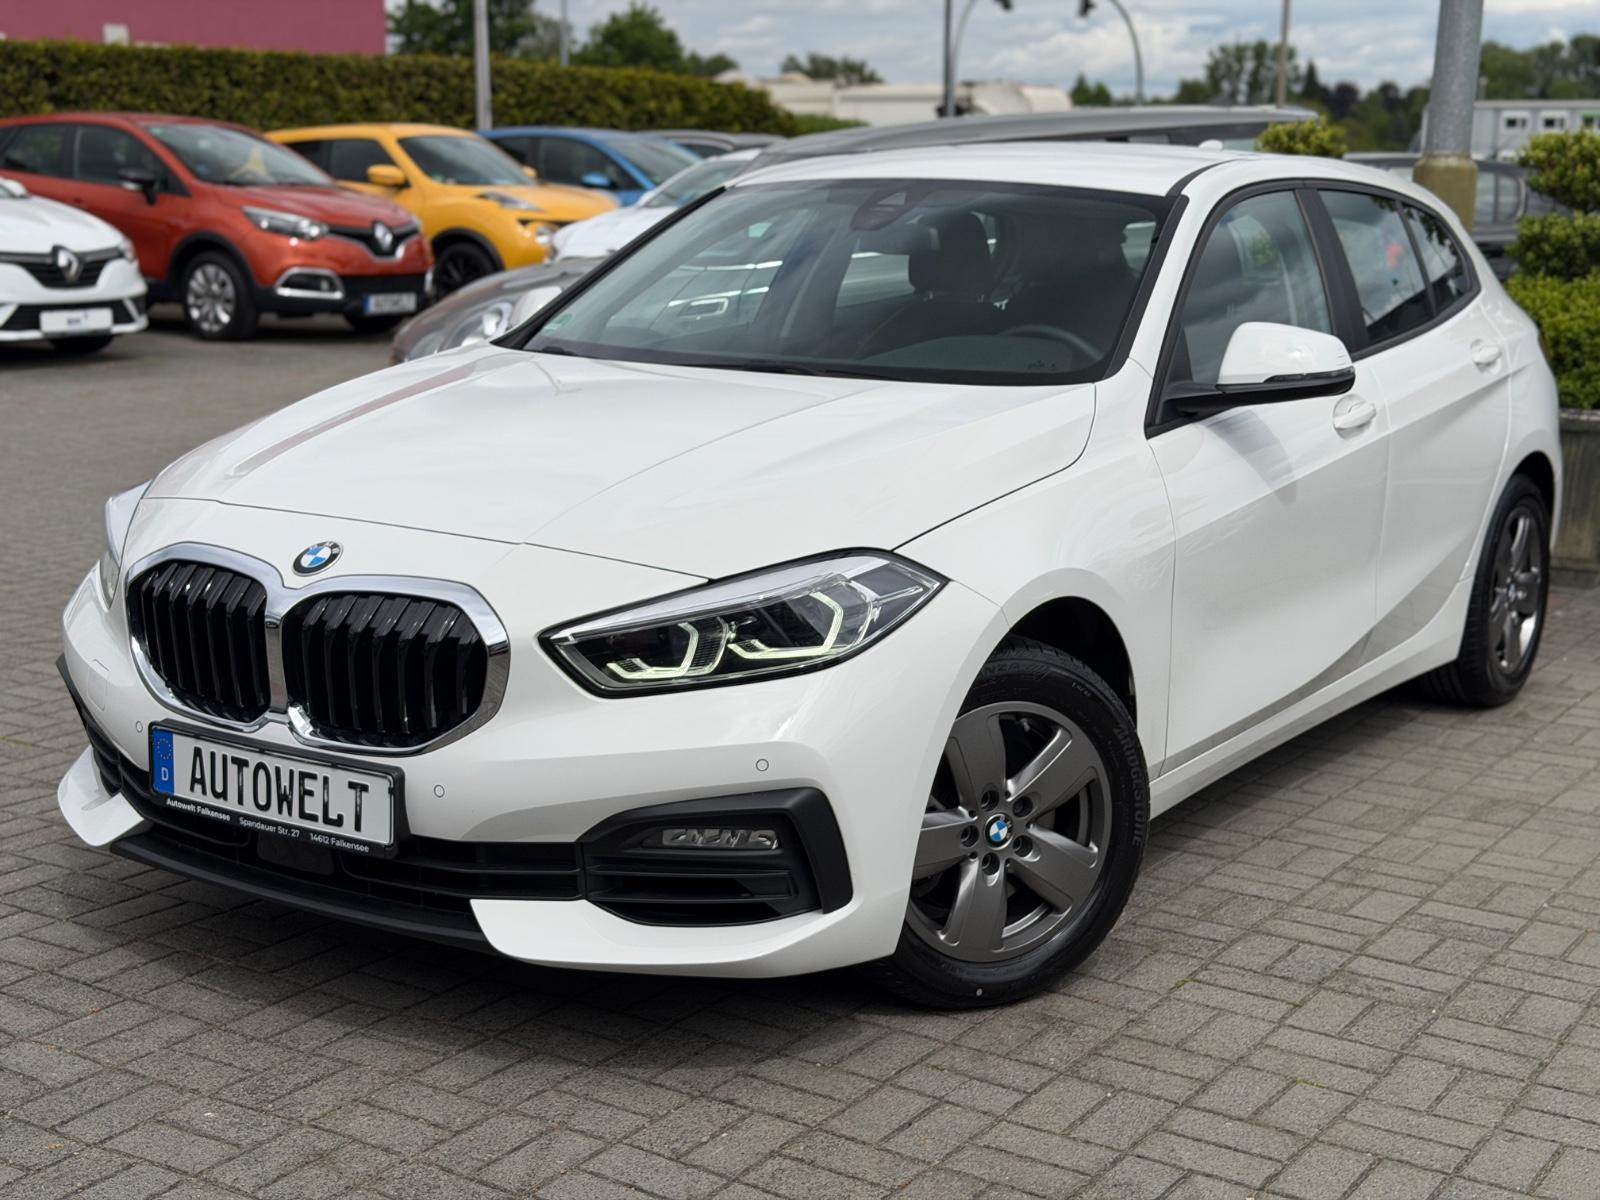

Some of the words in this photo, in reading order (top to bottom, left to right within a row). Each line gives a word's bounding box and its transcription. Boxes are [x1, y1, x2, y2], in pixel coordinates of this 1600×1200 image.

[161, 767, 169, 781] D
[189, 746, 369, 832] AUTOWELT
[166, 798, 196, 813] Autowelt
[196, 805, 231, 822] Falkensee
[239, 816, 276, 833] Spandauer
[277, 825, 291, 836] Str.
[291, 828, 300, 838] 27
[310, 832, 330, 845] 14612
[330, 837, 370, 853] Falkensee
